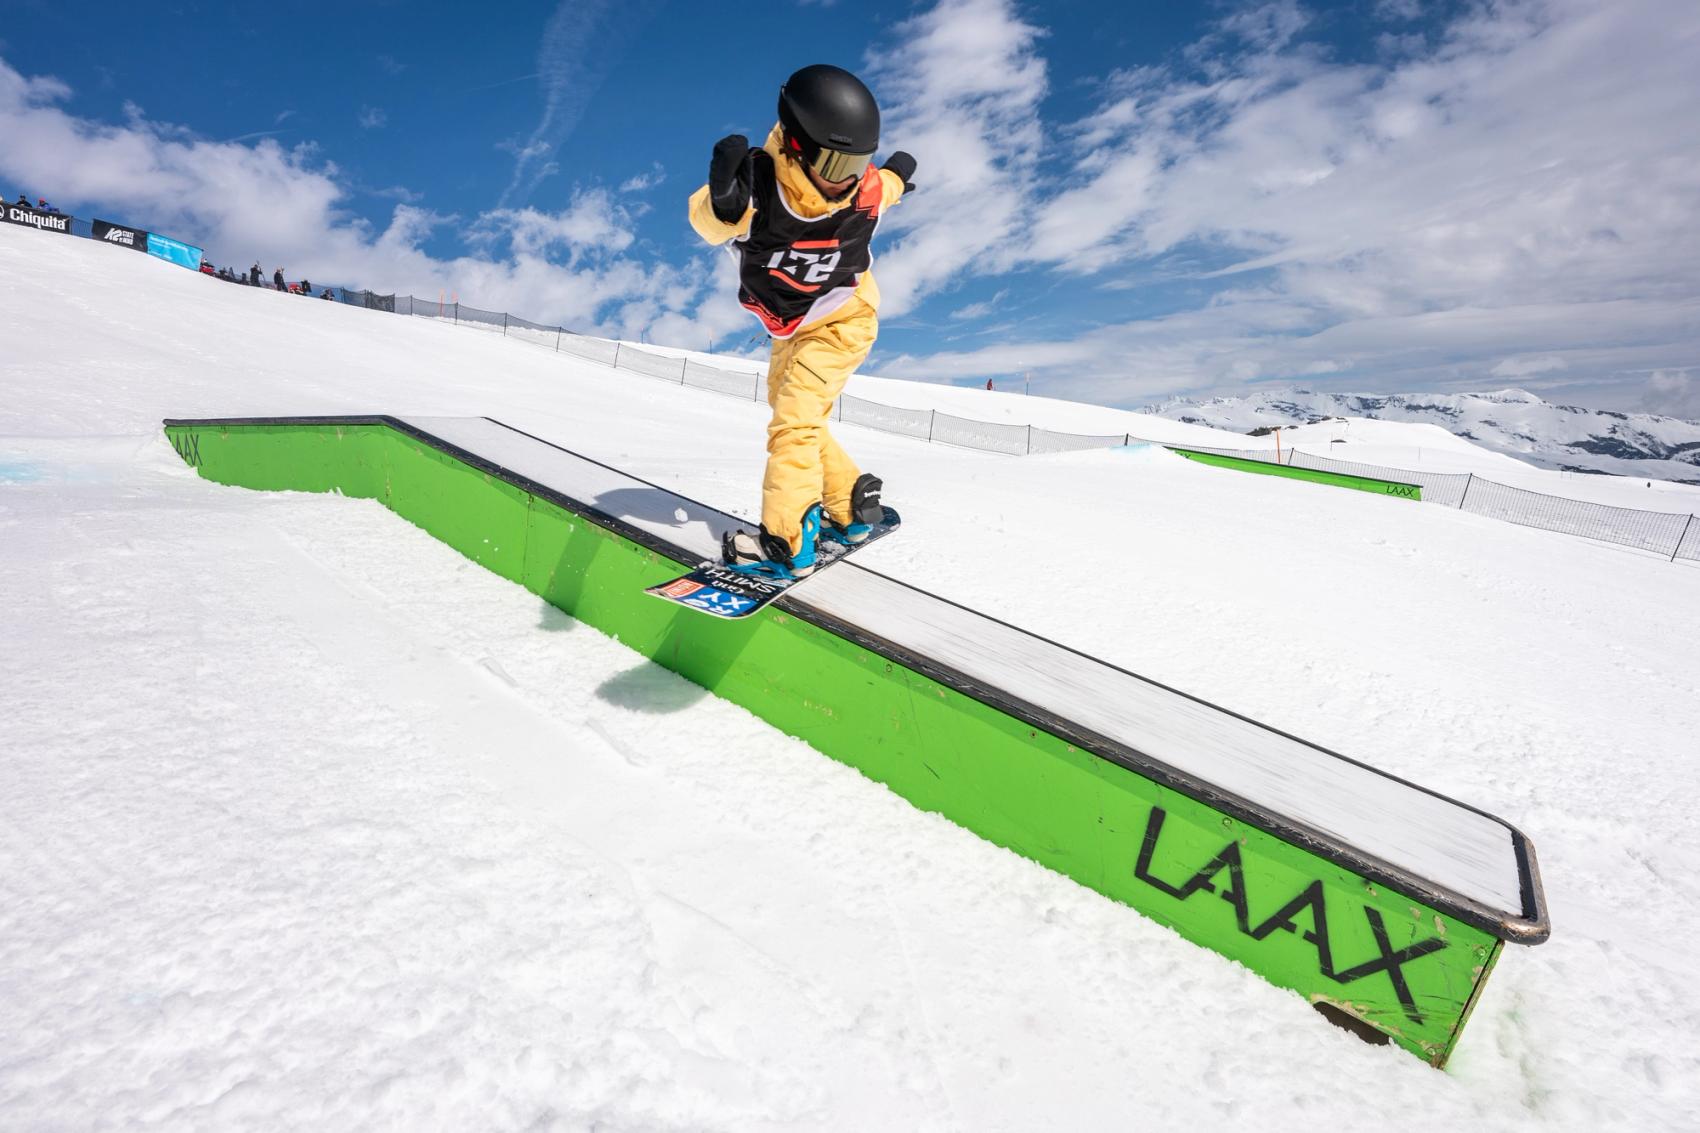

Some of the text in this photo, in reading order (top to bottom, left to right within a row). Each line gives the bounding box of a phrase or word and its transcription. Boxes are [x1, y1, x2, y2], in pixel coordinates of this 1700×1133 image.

[10, 208, 66, 230] Chiquita
[104, 227, 122, 241] K2
[766, 250, 842, 283] 172
[168, 433, 203, 466] AAX
[1386, 485, 1414, 497] LAAX
[705, 569, 776, 594] SMITH
[1135, 806, 1449, 1025] LAAX
